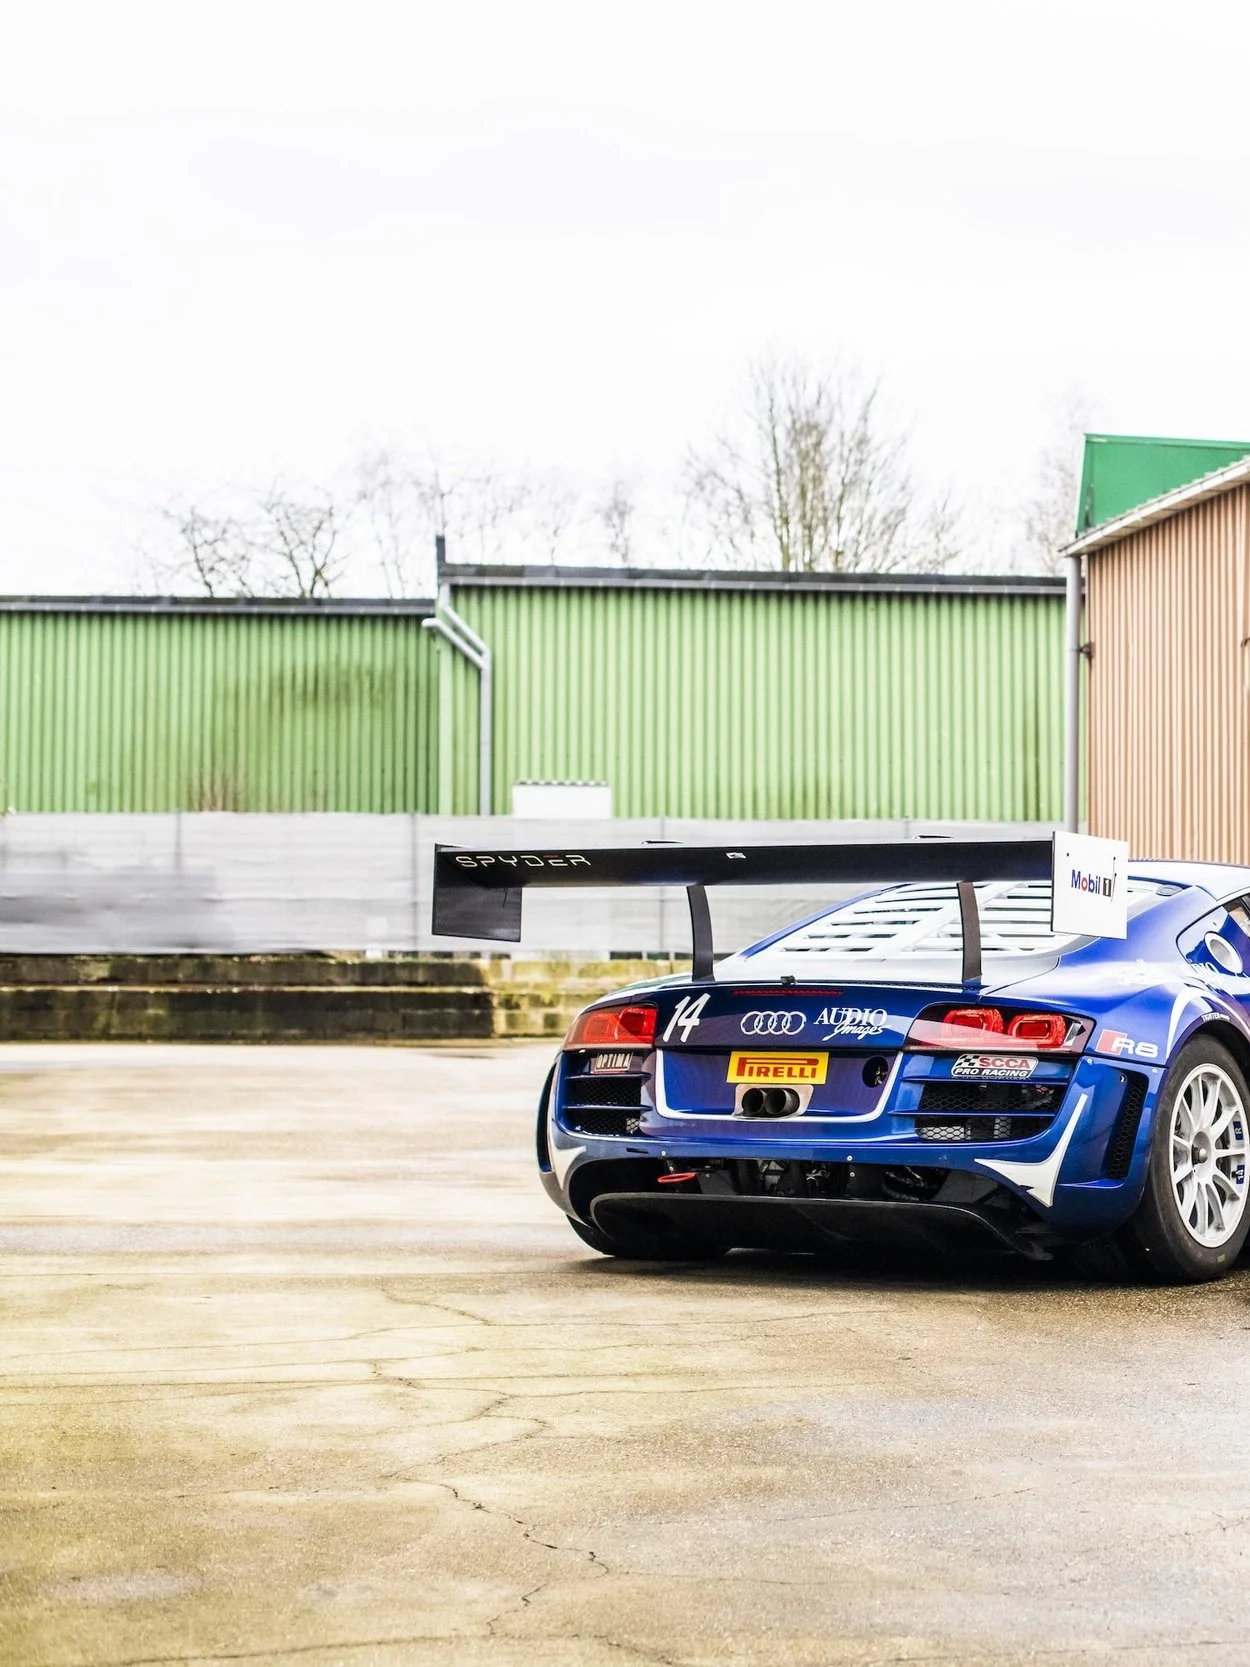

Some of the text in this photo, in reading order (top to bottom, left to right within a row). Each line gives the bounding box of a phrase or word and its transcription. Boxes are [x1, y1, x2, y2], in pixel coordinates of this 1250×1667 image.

[455, 855, 591, 868] SPYDER
[1071, 869, 1112, 897] Mobil 1
[663, 993, 711, 1043] 14
[813, 1007, 888, 1027] AUDIO
[1111, 1037, 1158, 1059] R8
[596, 1053, 631, 1069] OPTIMA
[736, 1056, 820, 1079] PIRELLI
[977, 1057, 1032, 1070] SCCA
[953, 1067, 1029, 1078] PRO RACING
